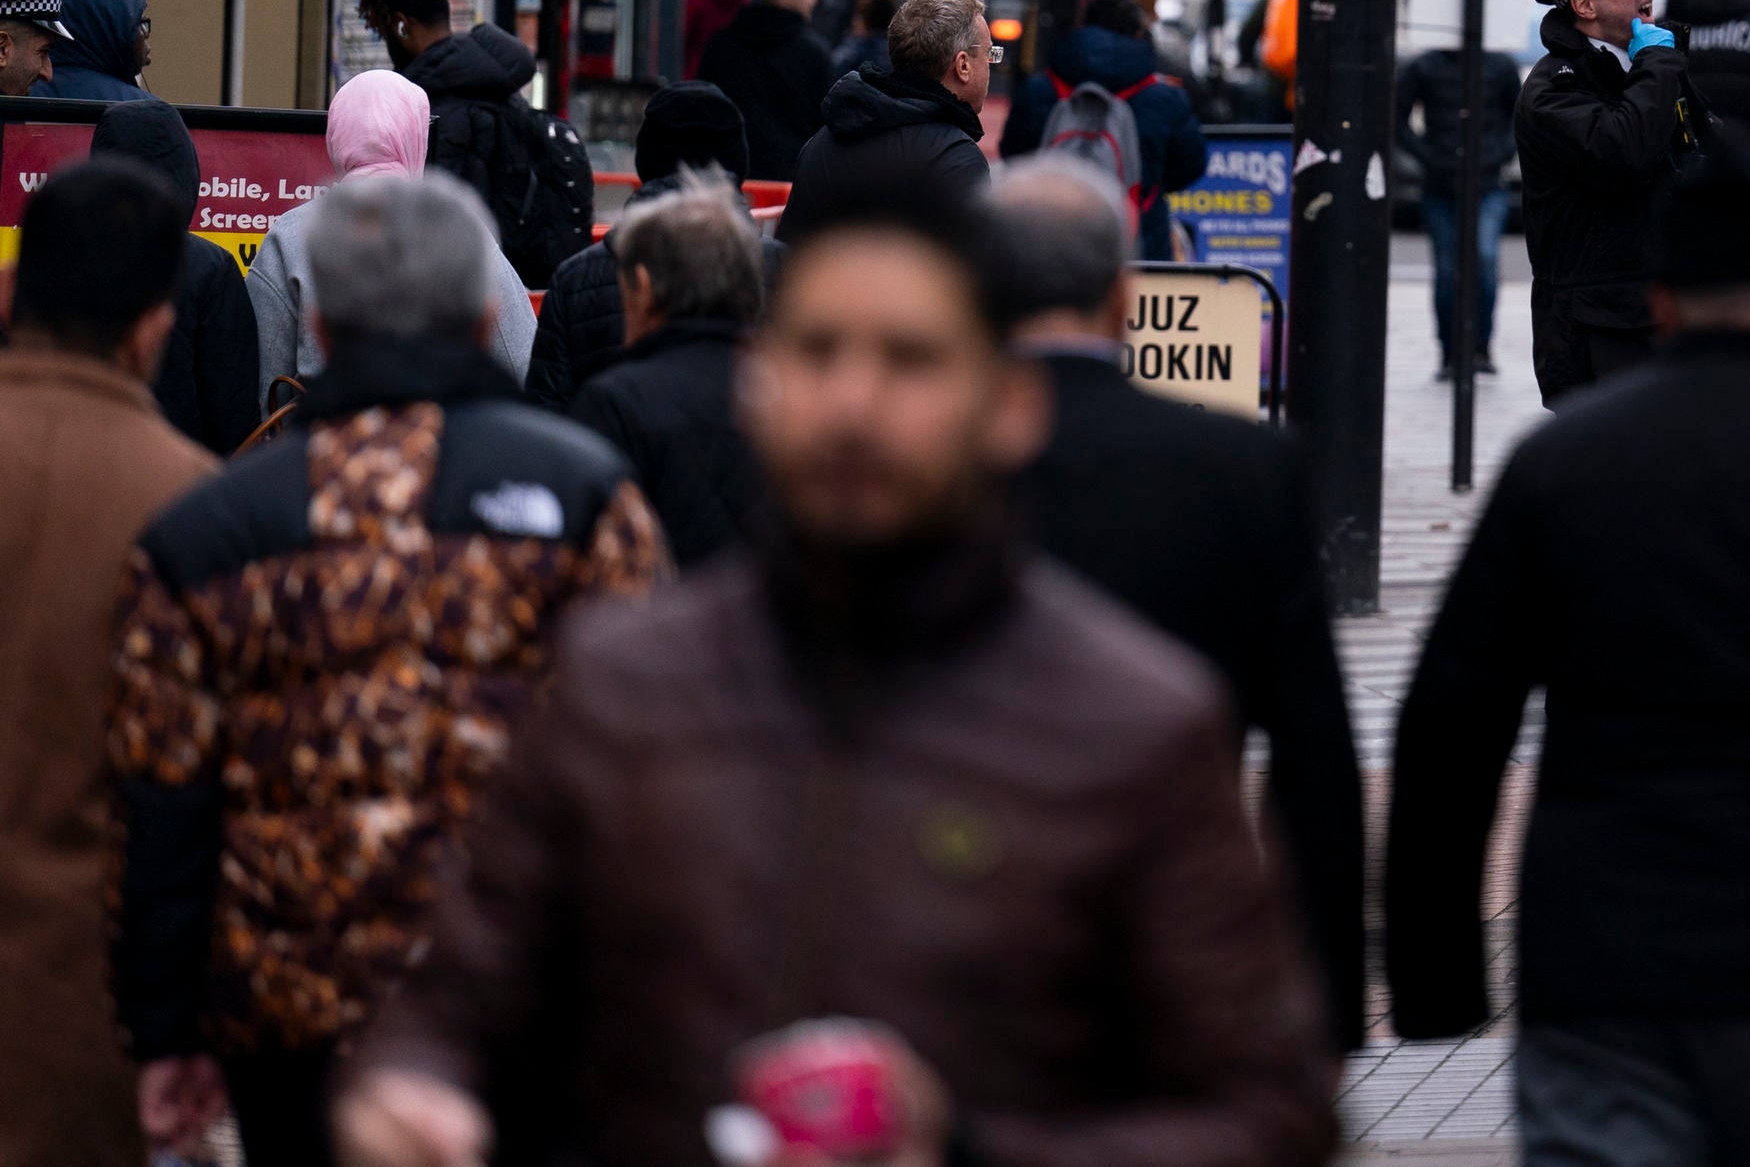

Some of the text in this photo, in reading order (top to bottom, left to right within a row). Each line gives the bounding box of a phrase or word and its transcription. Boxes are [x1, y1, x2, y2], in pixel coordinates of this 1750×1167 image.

[198, 177, 270, 202] obile,
[278, 179, 331, 201] Lap
[1206, 151, 1287, 195] ARDS
[1165, 190, 1273, 214] HONES
[1127, 295, 1199, 331] JUZ
[1119, 344, 1231, 380] OOKIN
